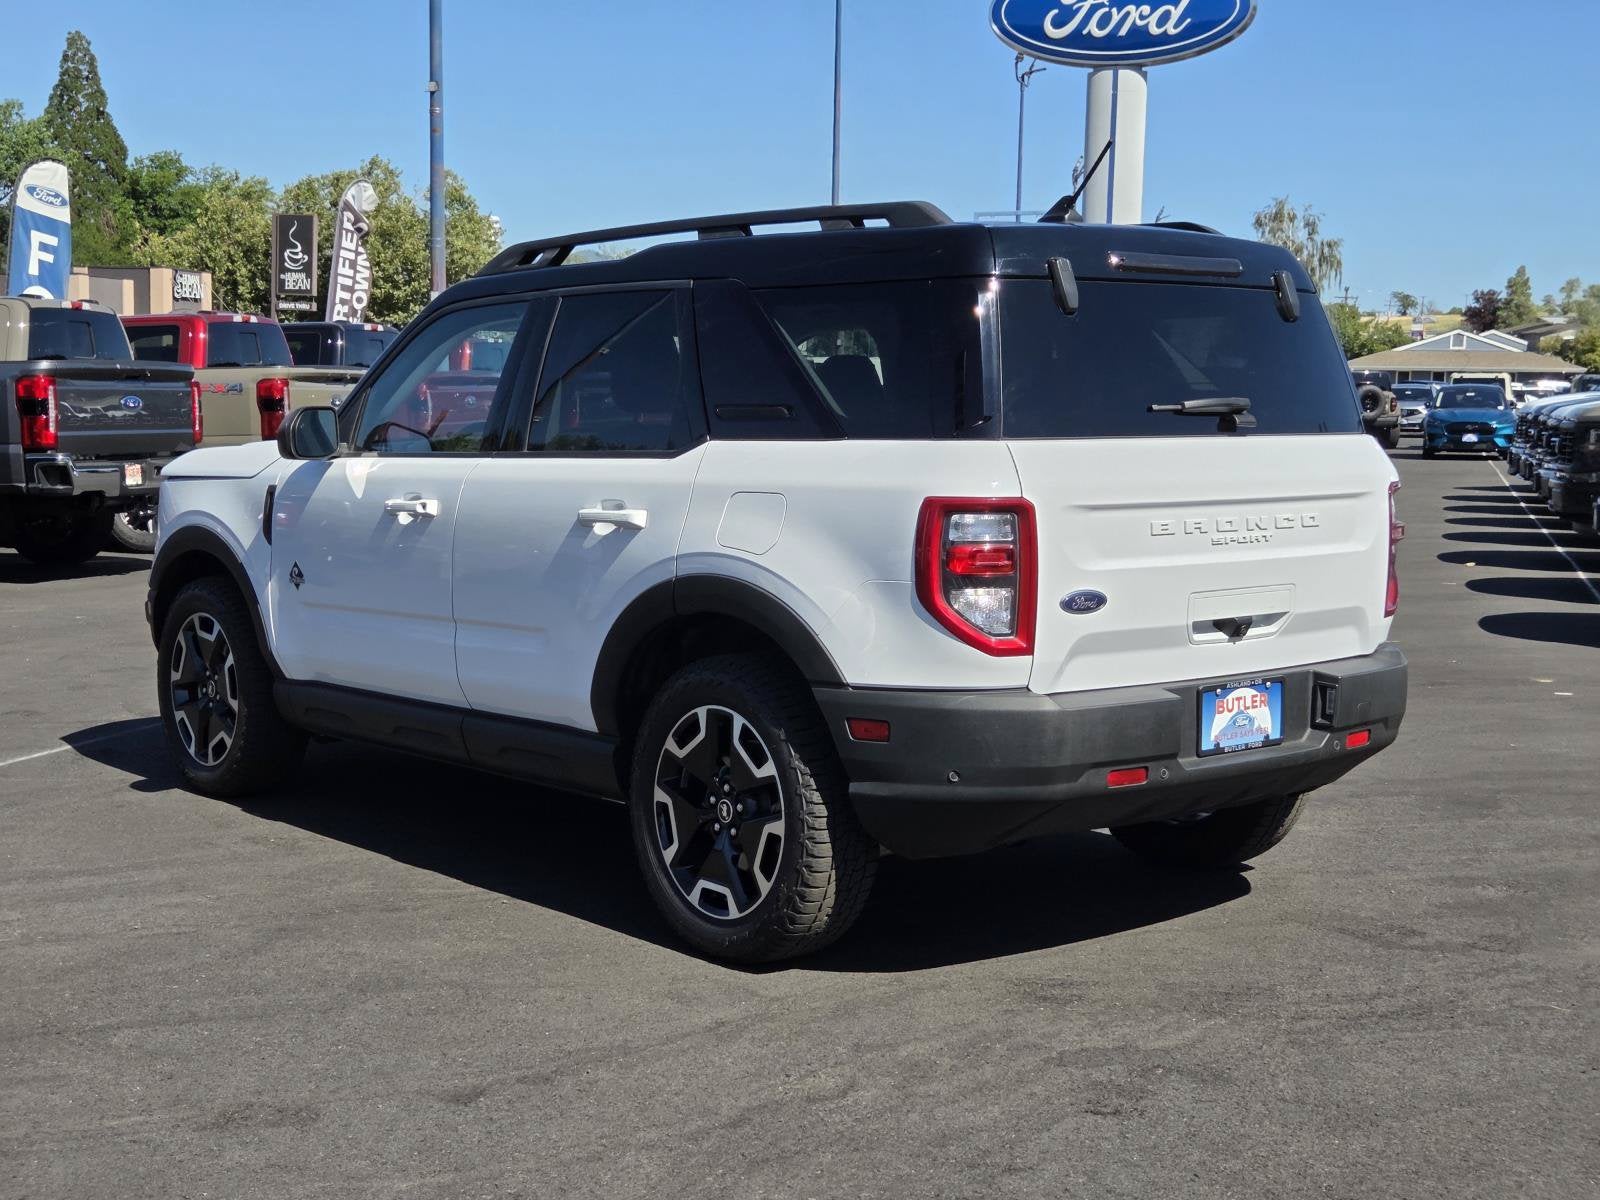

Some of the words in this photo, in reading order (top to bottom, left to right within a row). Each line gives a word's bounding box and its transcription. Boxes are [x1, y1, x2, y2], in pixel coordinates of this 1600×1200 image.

[1043, 0, 1191, 39] Ford
[33, 187, 62, 207] Ford
[285, 272, 306, 280] HUMAN
[181, 282, 204, 299] BEAN
[285, 279, 311, 289] BEAN
[1150, 512, 1320, 537] BRONCO
[1211, 534, 1273, 546] SPORT
[1072, 596, 1098, 609] Ford
[1216, 692, 1268, 715] BUTLER
[1224, 744, 1246, 753] BUTLER
[1248, 741, 1263, 749] FORD
